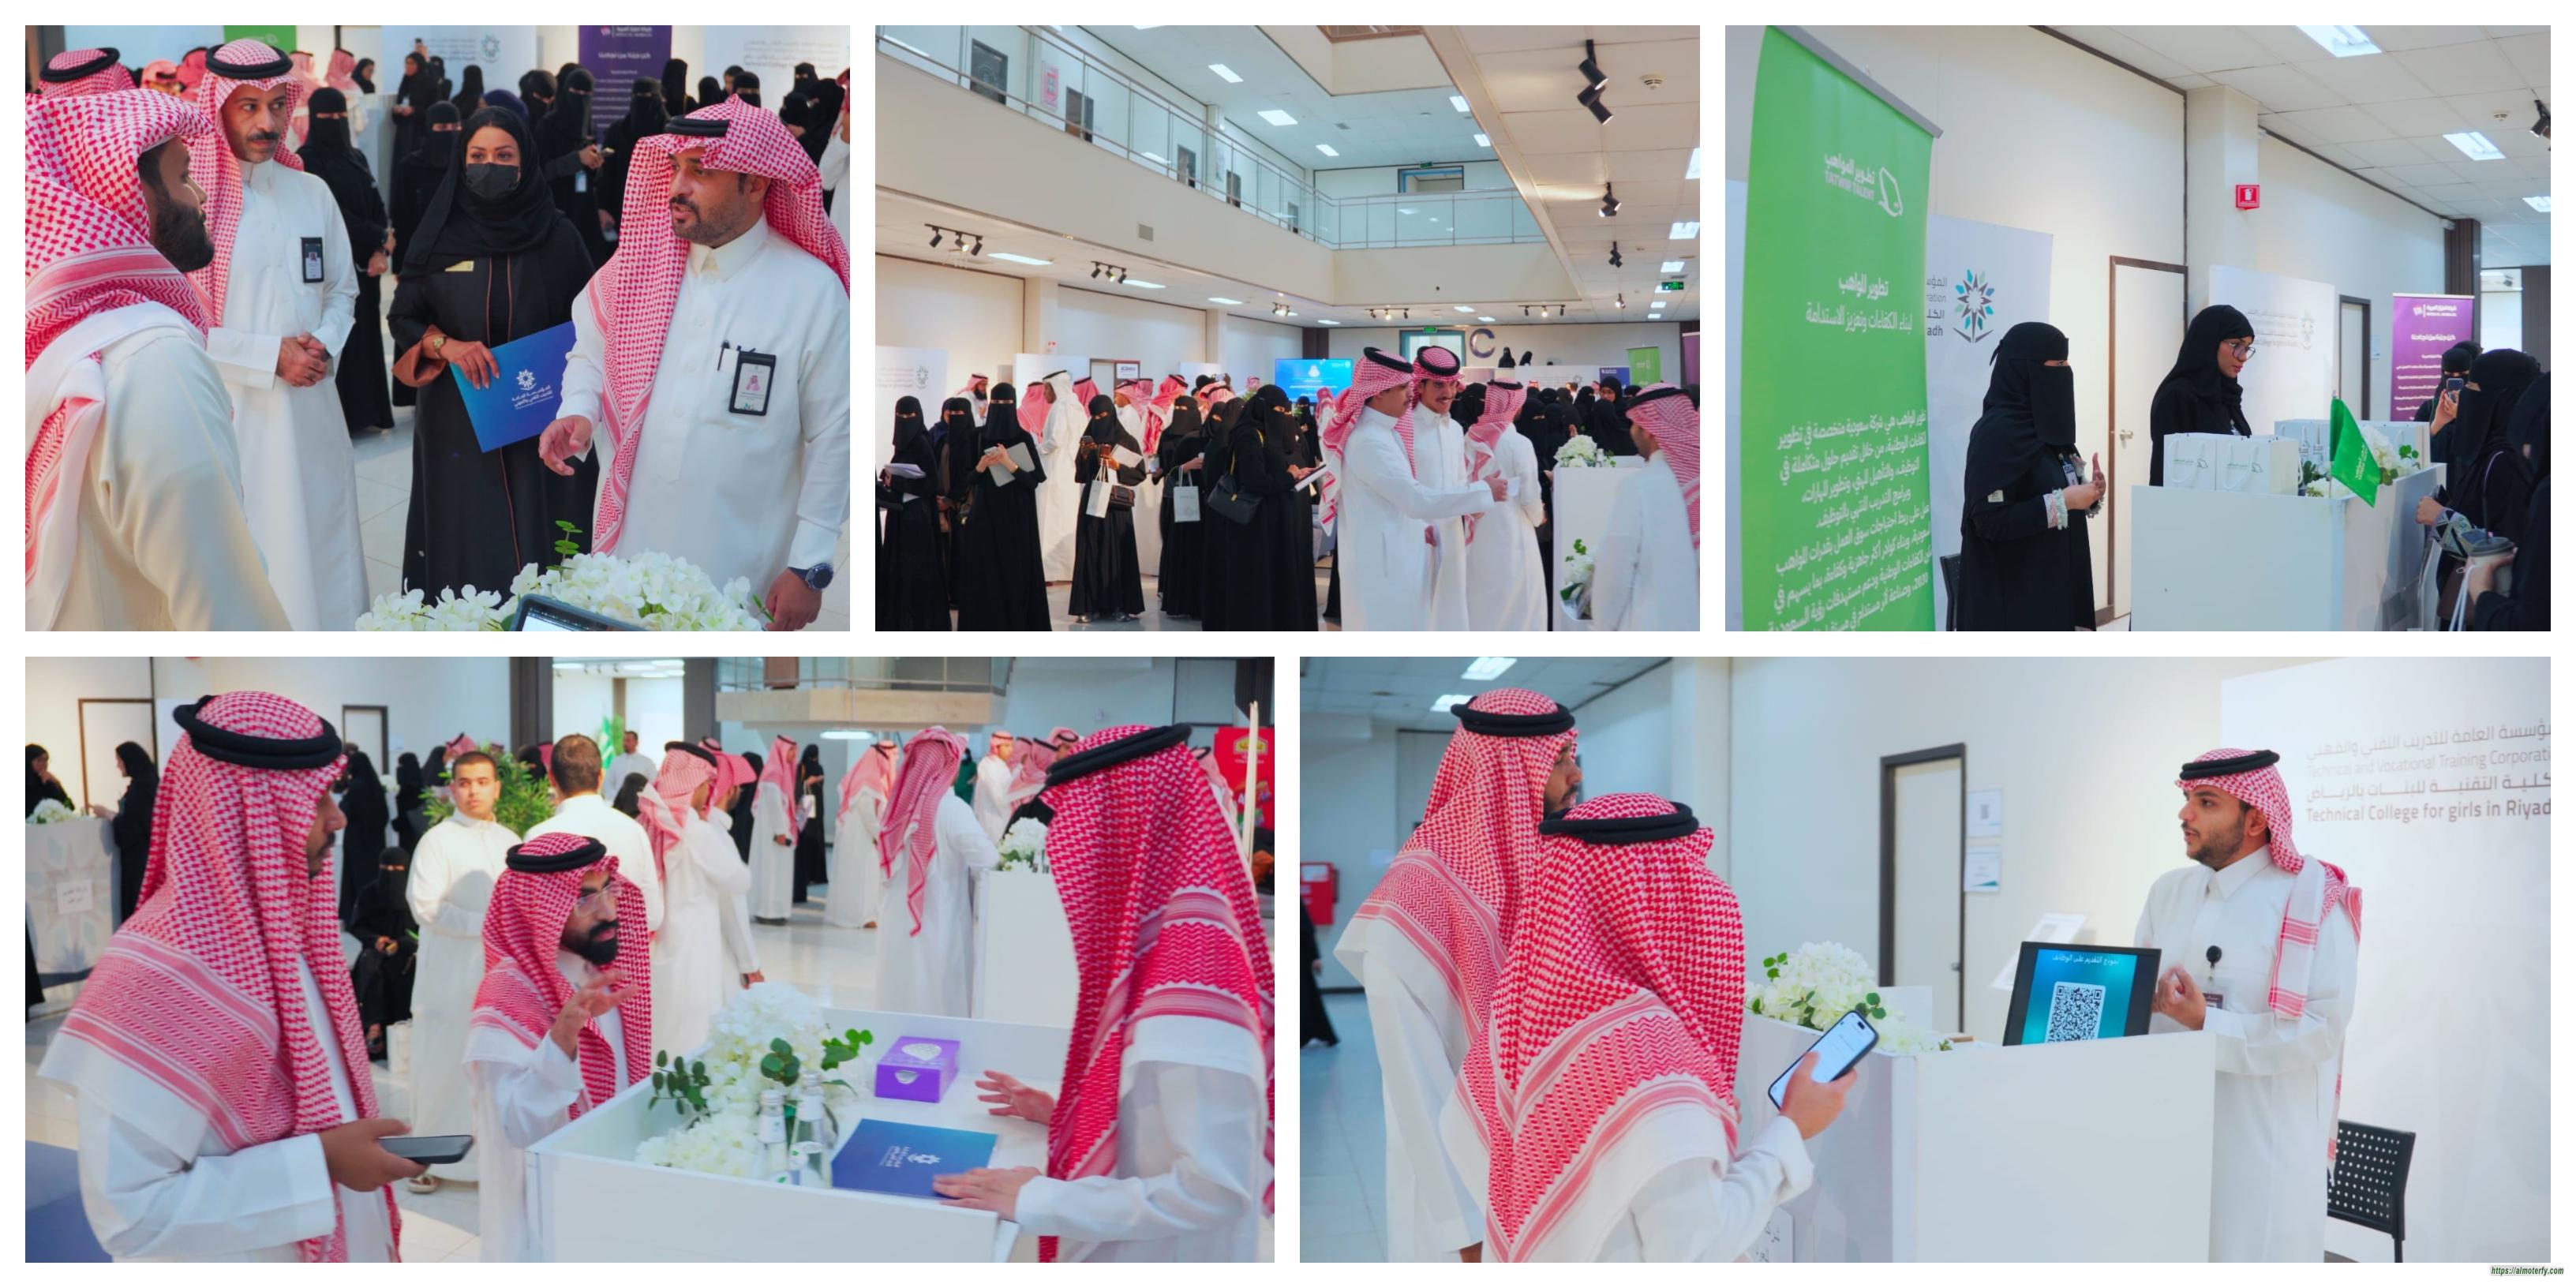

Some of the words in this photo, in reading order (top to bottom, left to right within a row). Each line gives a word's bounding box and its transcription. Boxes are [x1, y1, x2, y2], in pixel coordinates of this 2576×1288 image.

[1867, 277, 1889, 301] تطوير
[1926, 274, 1948, 289] المؤس
[1926, 294, 1946, 303] ration
[1805, 301, 1845, 326] الاستدامة
[1926, 324, 1944, 336] adh
[1777, 424, 1804, 450] تطوير
[1804, 421, 1813, 450] في
[1780, 455, 1791, 486] في
[1774, 584, 1785, 615] في
[2361, 735, 2400, 755] التقني
[2402, 730, 2448, 751] للتدريب
[2452, 725, 2495, 744] العامة
[2306, 739, 2359, 761] والمهني
[2353, 760, 2374, 775] and
[2378, 755, 2436, 774] Vocational
[2439, 754, 2487, 770] Training
[2306, 804, 2364, 822] Technical
[2368, 803, 2419, 823] College
[2423, 801, 2444, 818] for
[2448, 799, 2481, 822] girls
[2486, 799, 2500, 817] in
[2507, 797, 2551, 819] Riyad
